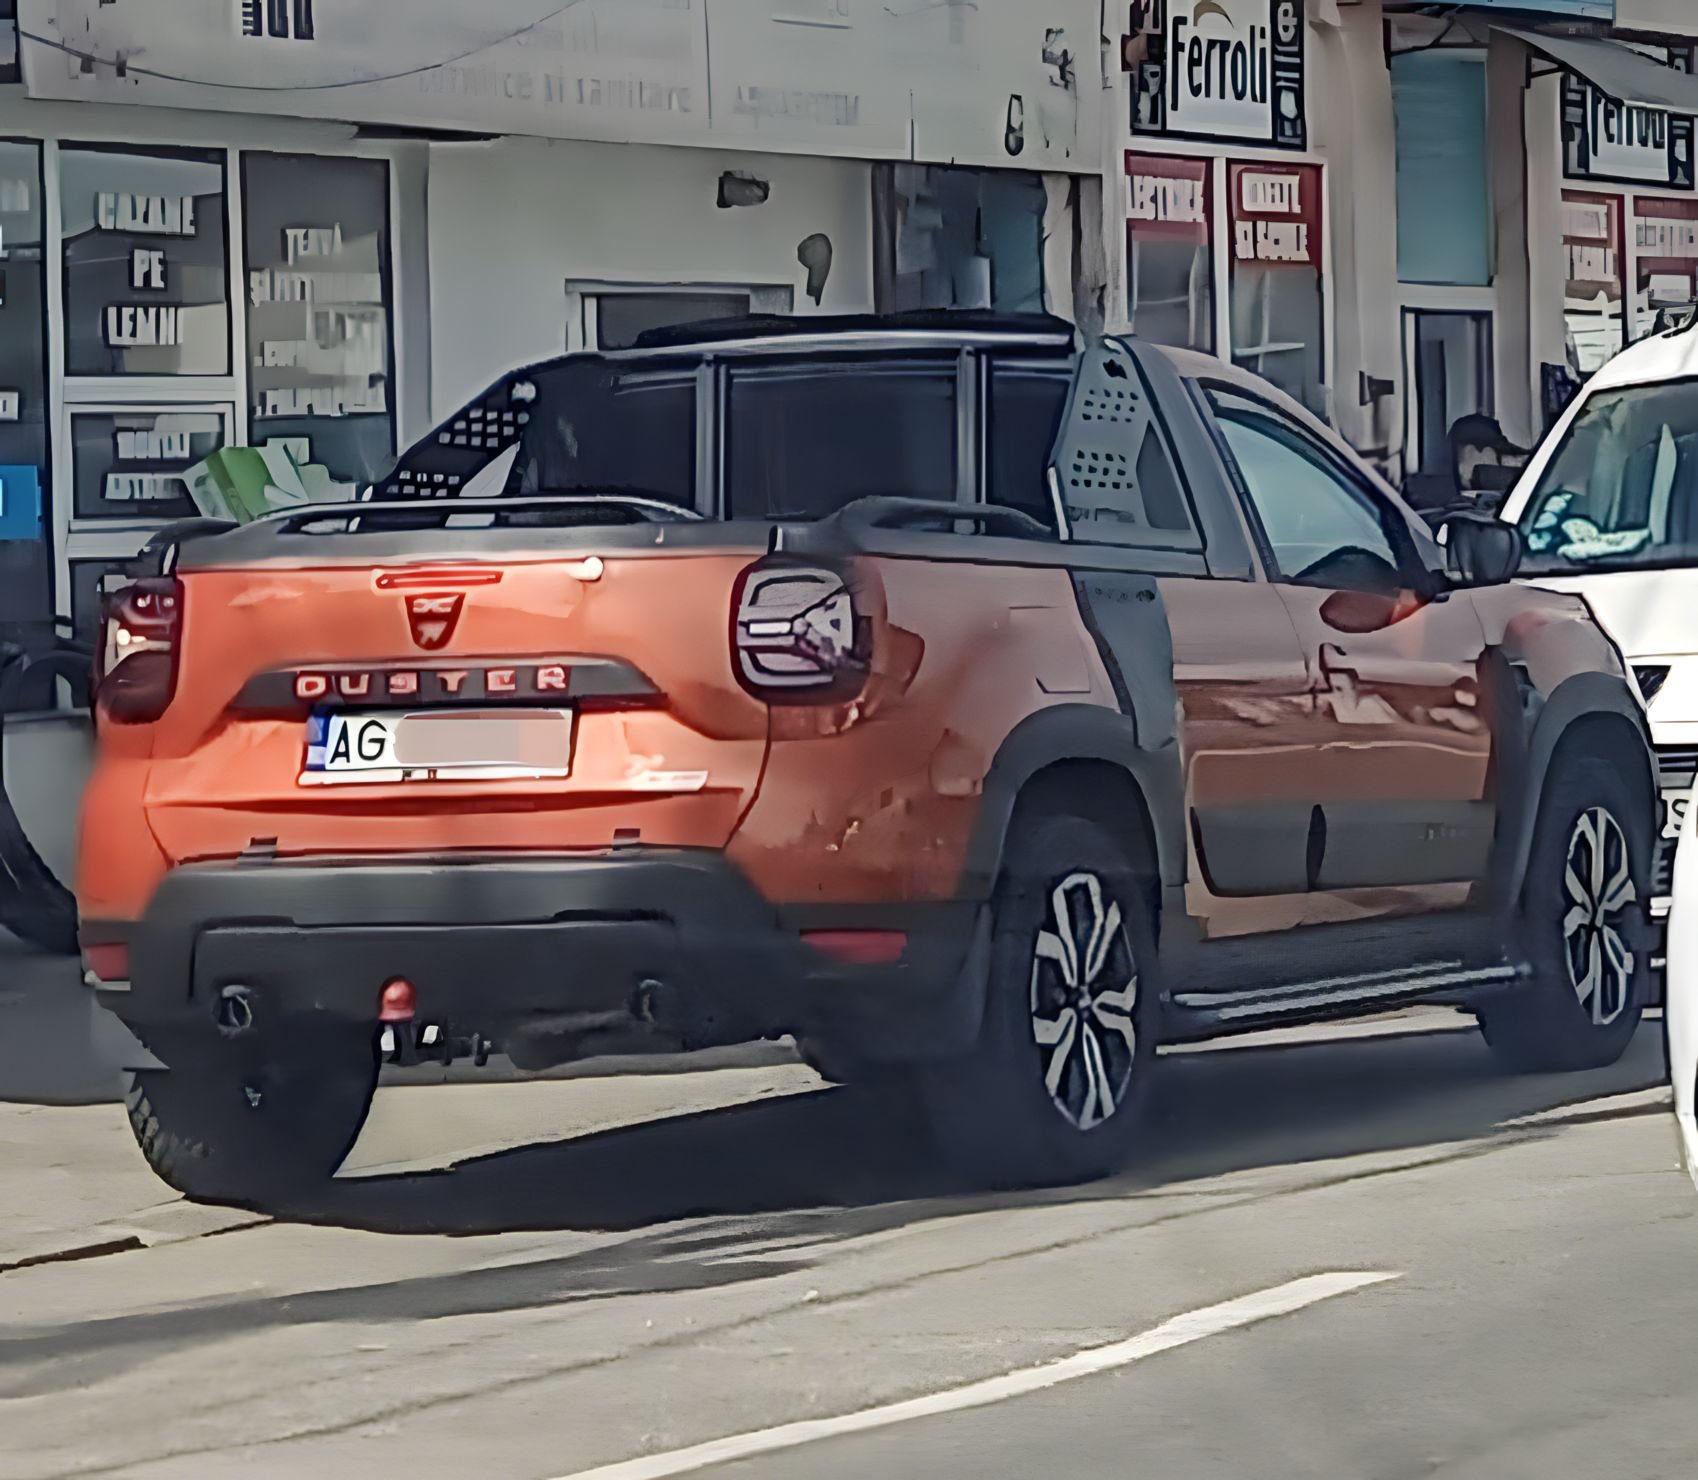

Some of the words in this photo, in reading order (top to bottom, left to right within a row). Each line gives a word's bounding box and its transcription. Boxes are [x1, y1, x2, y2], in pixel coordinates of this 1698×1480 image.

[1170, 15, 1268, 112] Ferroli
[133, 248, 166, 289] PE
[296, 664, 569, 698] DUSTER
[328, 718, 388, 765] AG
